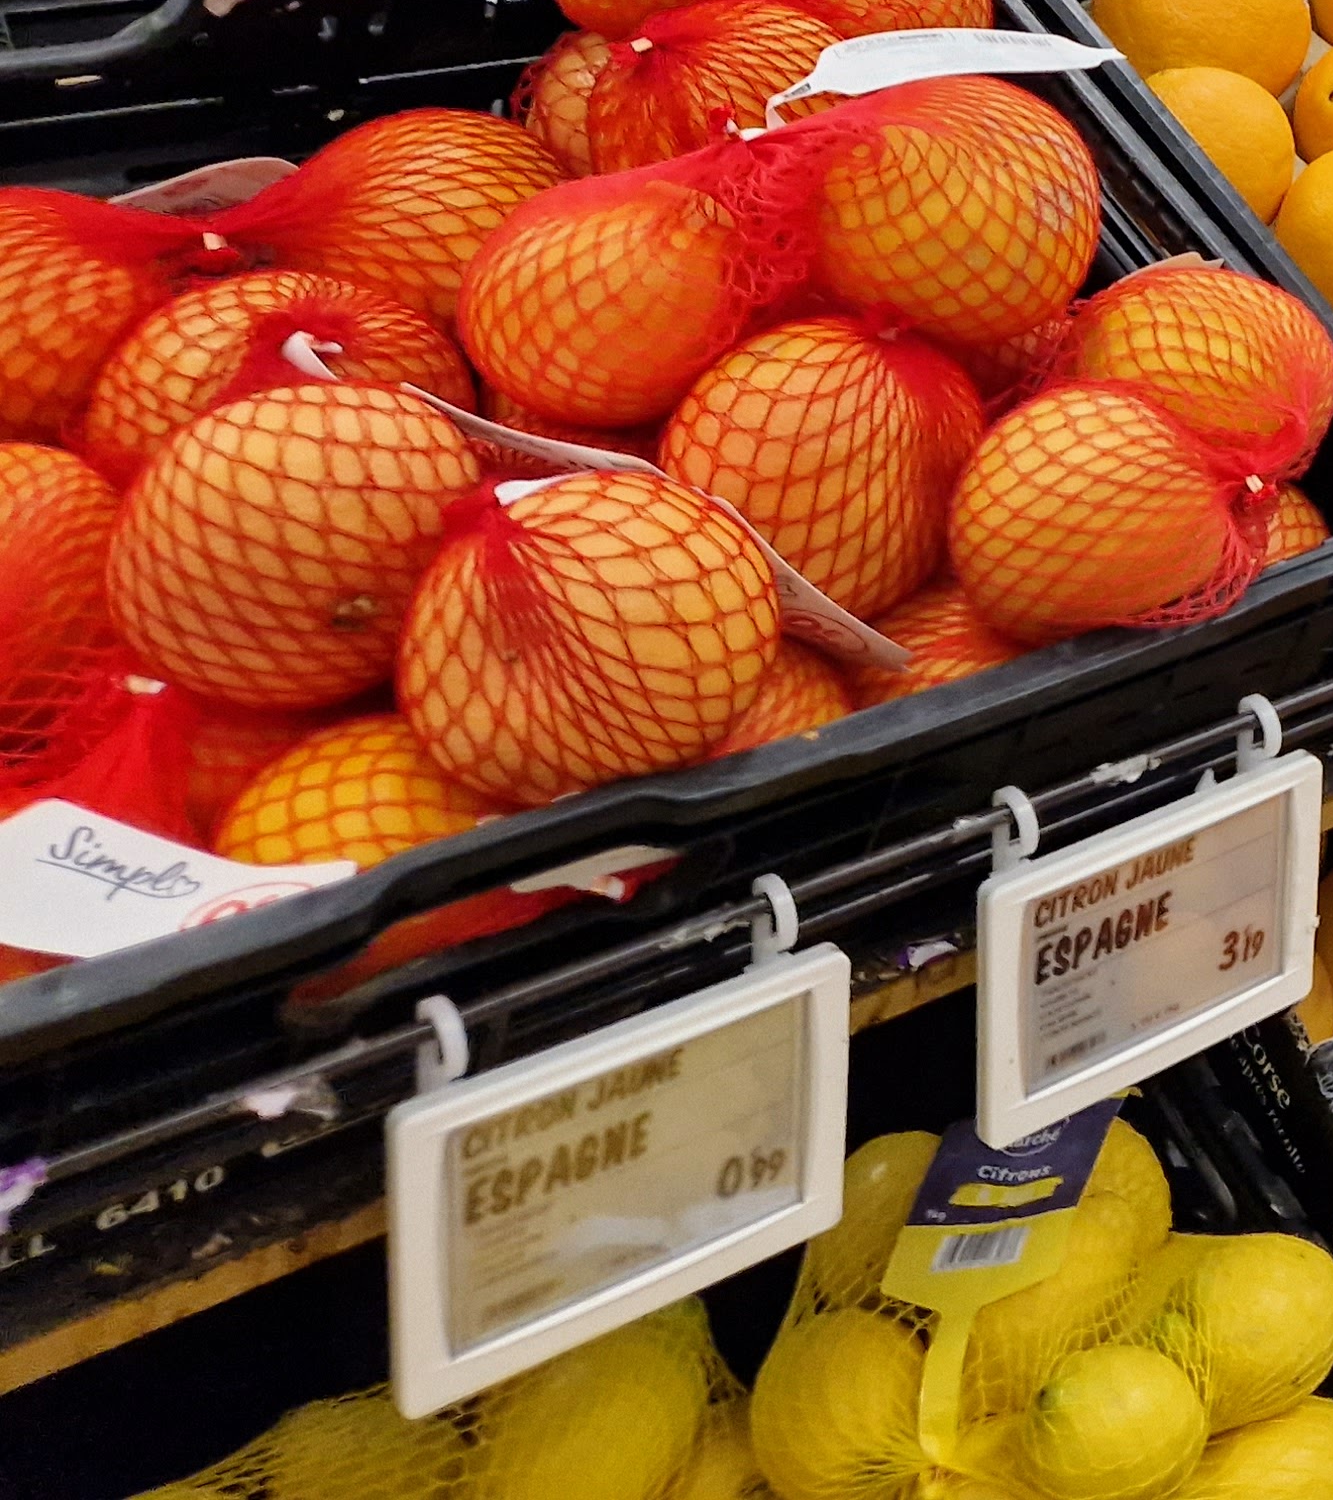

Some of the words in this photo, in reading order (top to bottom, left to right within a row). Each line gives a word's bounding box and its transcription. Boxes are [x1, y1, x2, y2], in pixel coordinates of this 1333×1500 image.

[1033, 869, 1119, 929] CITRON
[1126, 837, 1198, 890] JAUNE
[1034, 889, 1172, 985] ESPAGNE
[462, 1092, 579, 1161] CITRON
[586, 1048, 686, 1112] JAUNE
[464, 1111, 652, 1228] ESPAGNE
[976, 1164, 1053, 1182] Citrons
